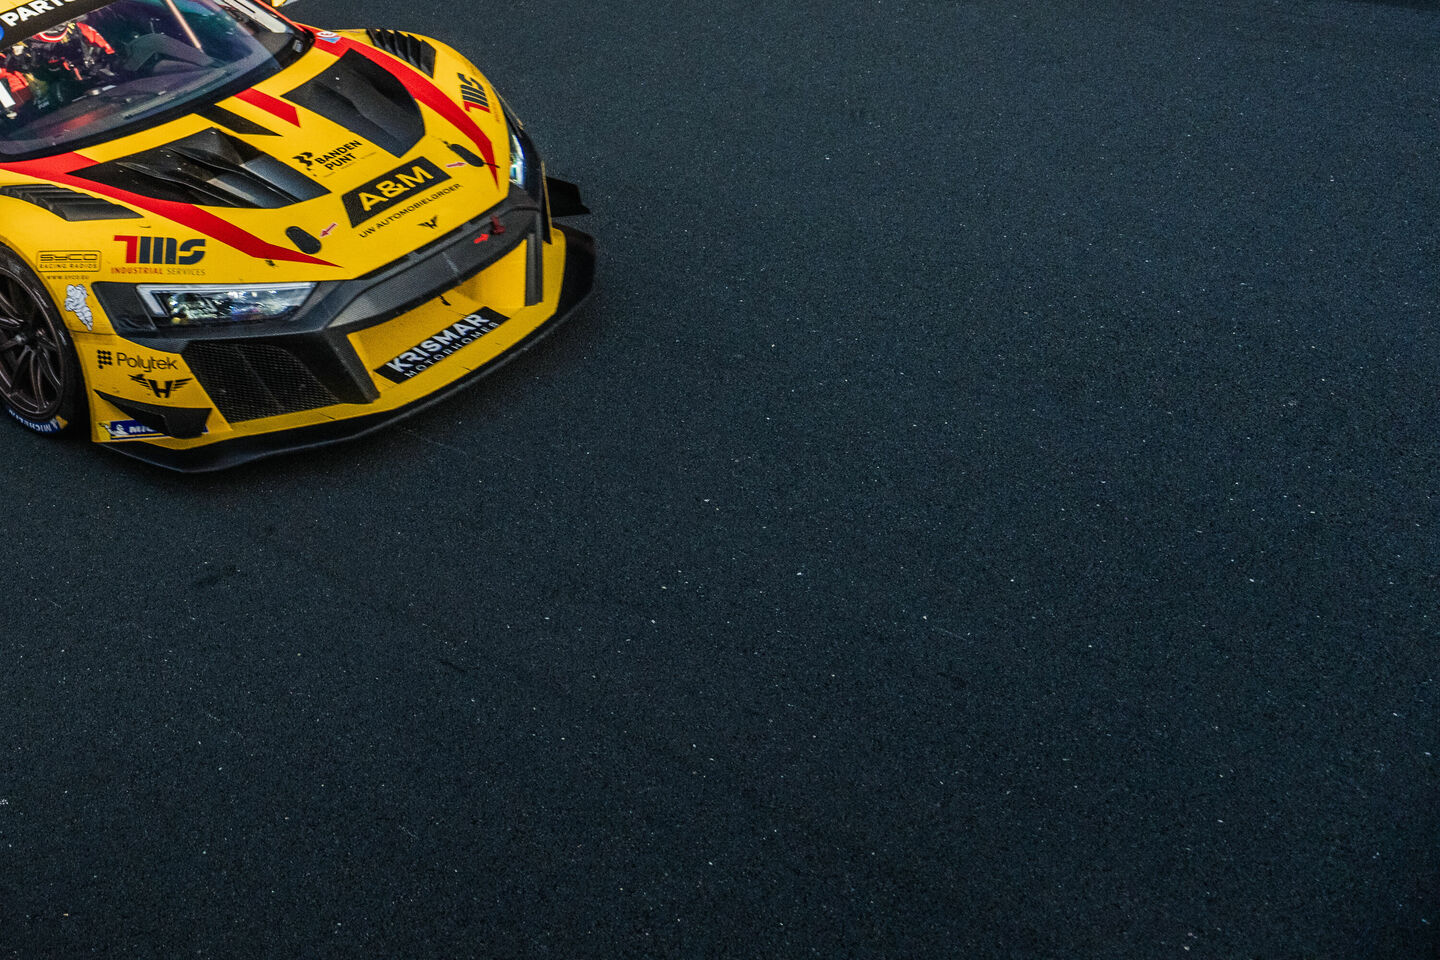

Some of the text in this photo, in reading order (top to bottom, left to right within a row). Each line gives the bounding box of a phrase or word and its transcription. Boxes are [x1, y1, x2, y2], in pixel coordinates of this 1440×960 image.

[314, 140, 362, 165] BANDEN
[324, 153, 358, 171] PUNT
[358, 165, 435, 212] A&M
[359, 227, 376, 239] UW
[111, 267, 206, 276] INDUSTRIAL SERVICES
[385, 313, 490, 373] KRISMAR
[116, 352, 178, 373] Polytek
